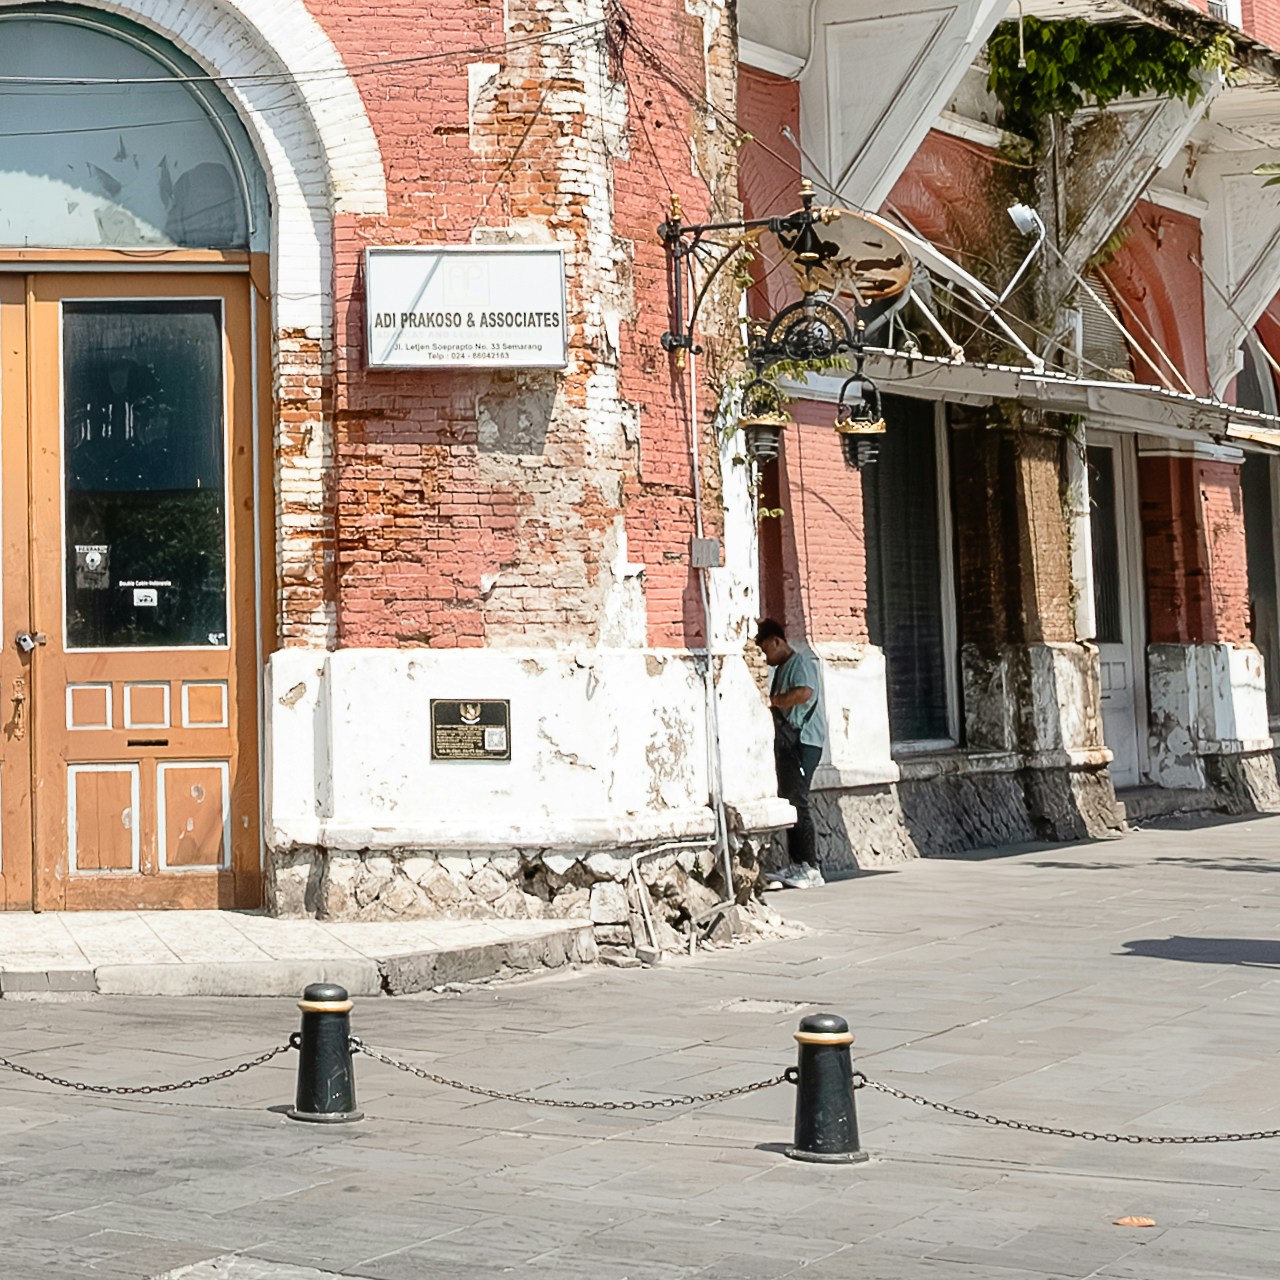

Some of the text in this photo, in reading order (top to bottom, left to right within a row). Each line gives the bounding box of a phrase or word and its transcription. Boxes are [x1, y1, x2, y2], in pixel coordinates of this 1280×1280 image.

[374, 312, 560, 328] ADI PRAKOSO & ASSOCIATES
[405, 344, 430, 352] Letjen
[502, 343, 543, 351] Semarang
